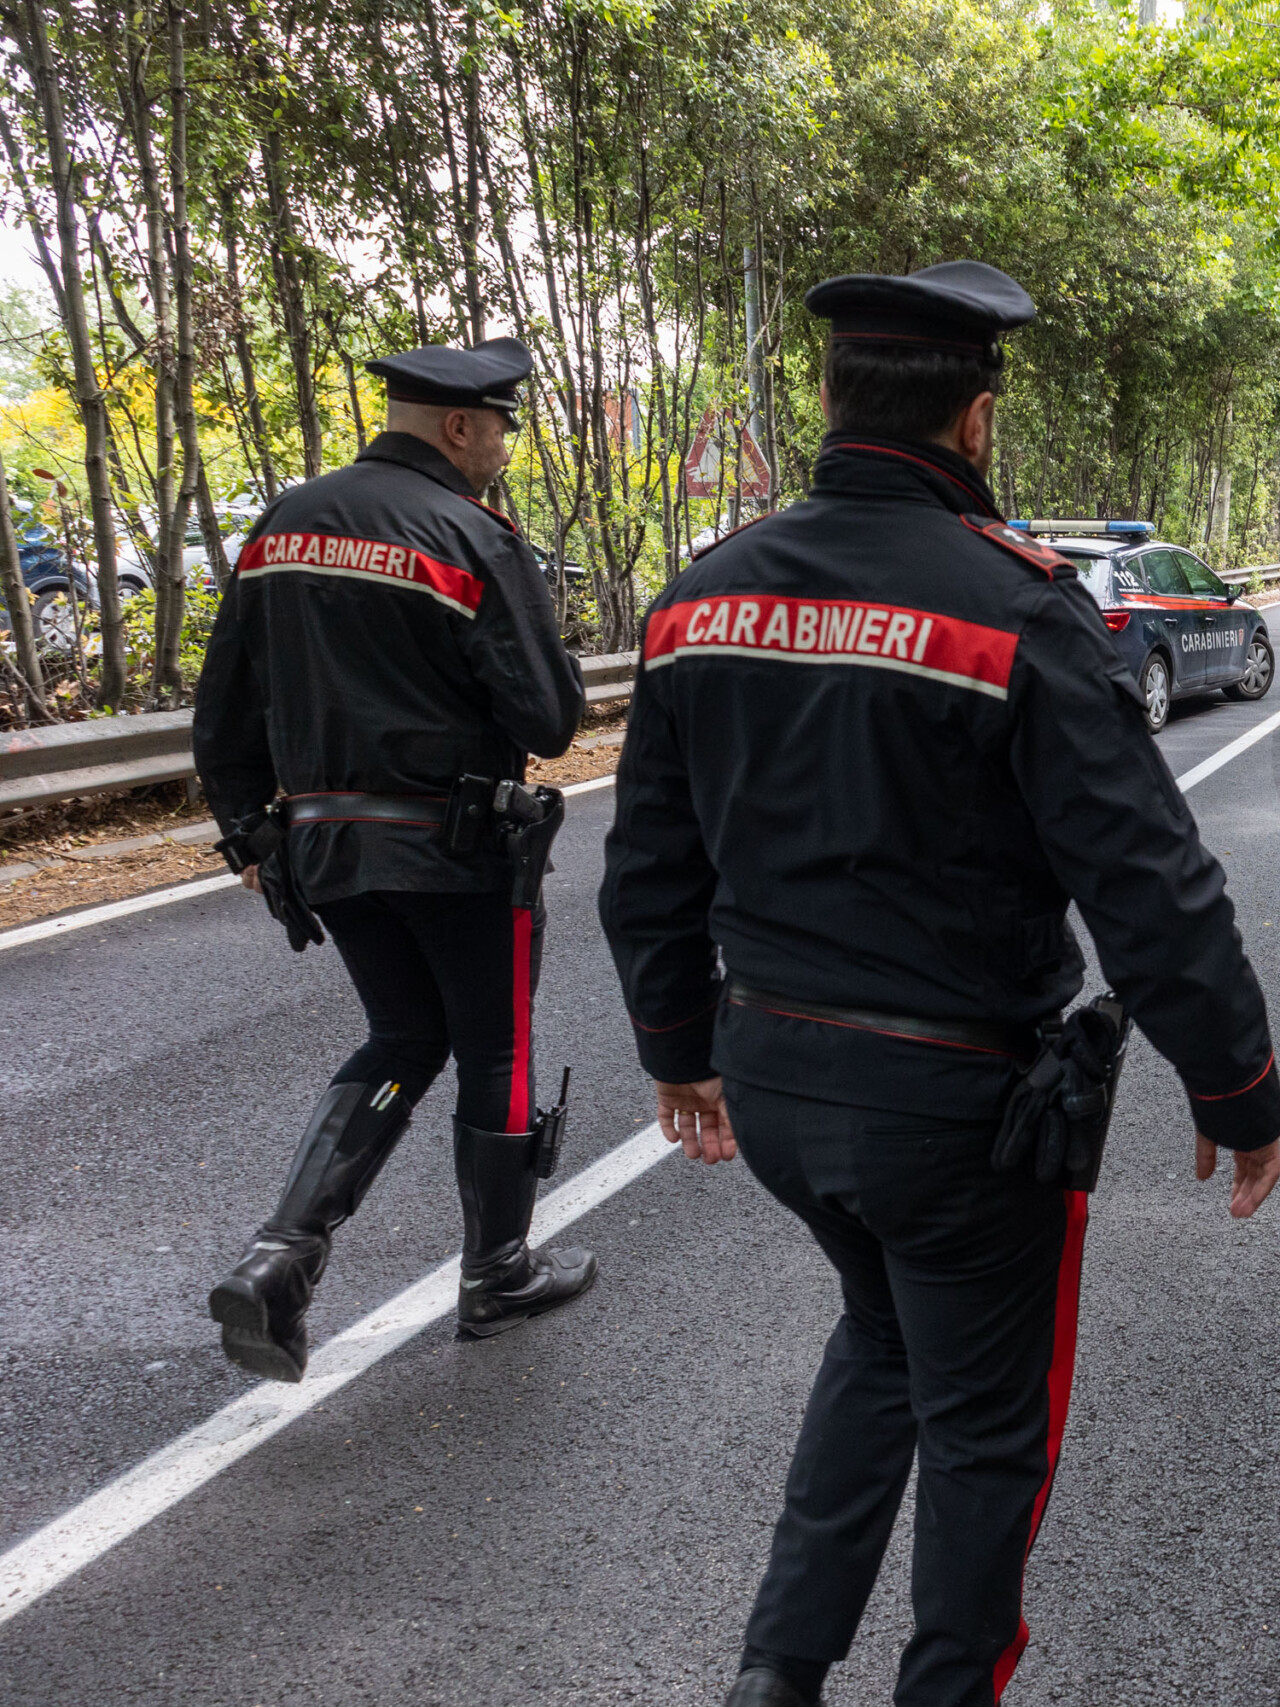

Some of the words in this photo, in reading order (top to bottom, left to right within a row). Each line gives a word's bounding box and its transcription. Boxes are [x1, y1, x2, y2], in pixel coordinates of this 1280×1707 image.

[264, 535, 416, 579] CARABINIERI
[1112, 570, 1140, 587] 112
[686, 601, 933, 662] CARABINIERI
[1181, 629, 1238, 653] CARABINIERI
